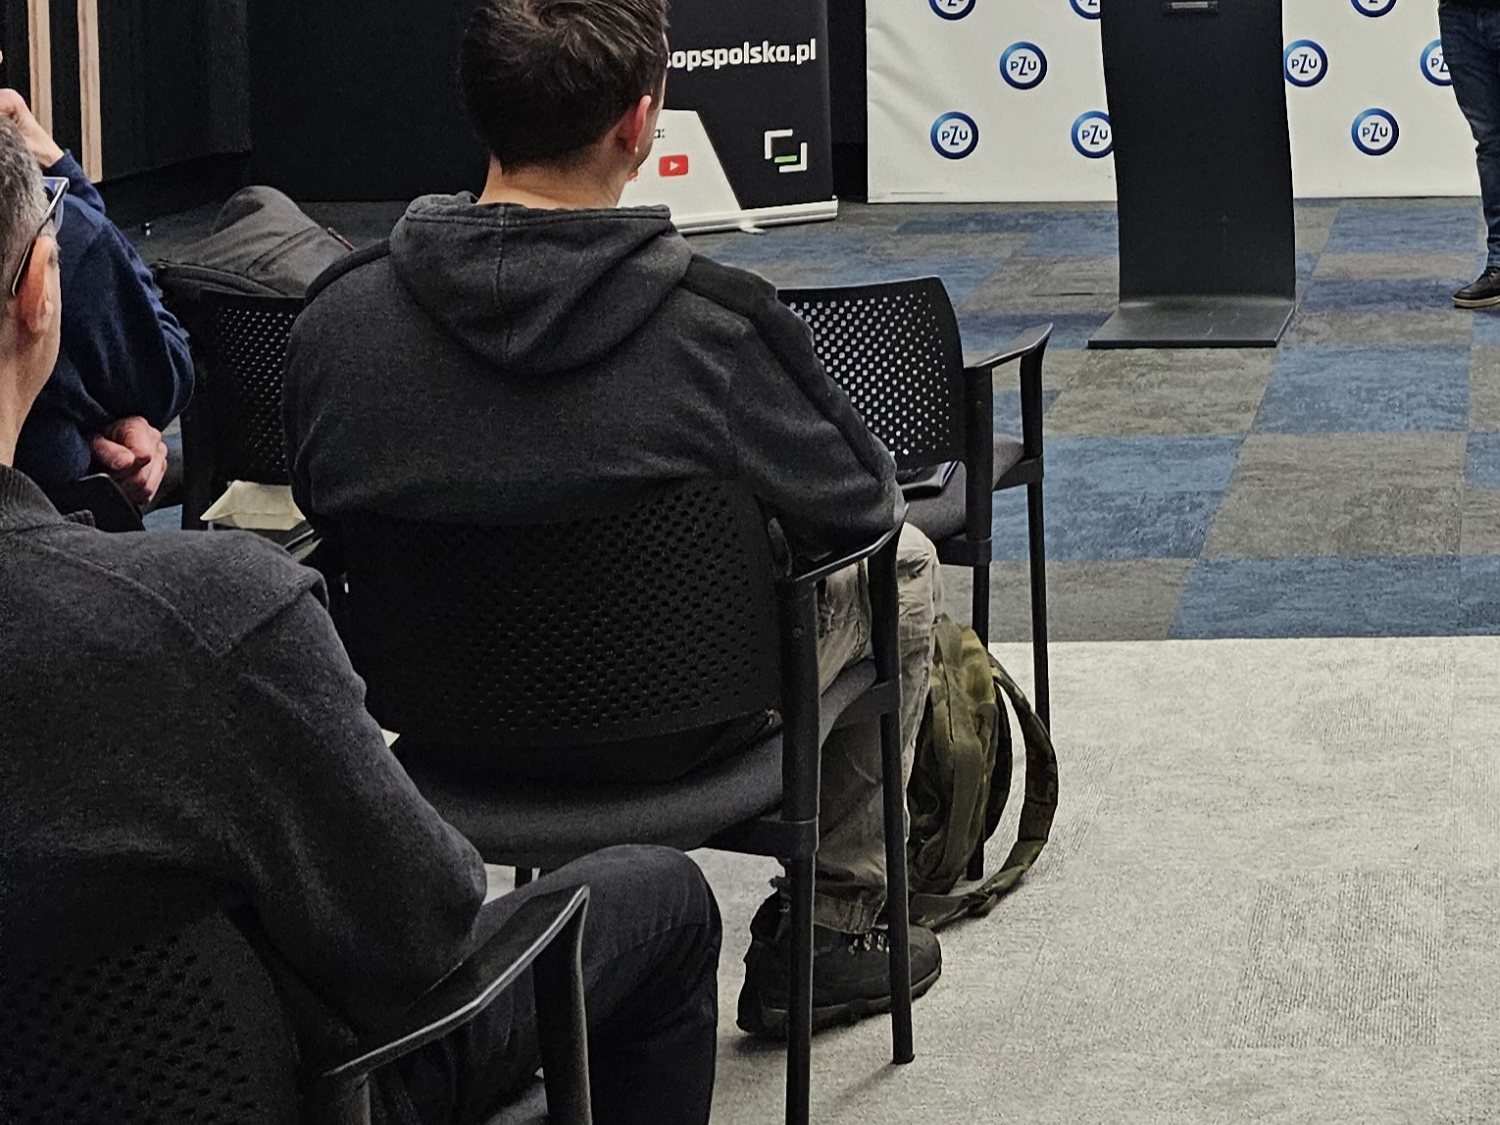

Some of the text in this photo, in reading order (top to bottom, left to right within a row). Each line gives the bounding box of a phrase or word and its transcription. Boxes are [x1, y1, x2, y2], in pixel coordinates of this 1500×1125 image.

[1011, 56, 1036, 76] PZU
[1292, 54, 1317, 73] PZU
[942, 126, 968, 145] PZU
[1082, 125, 1108, 145] PZU
[1363, 123, 1388, 142] PZU
